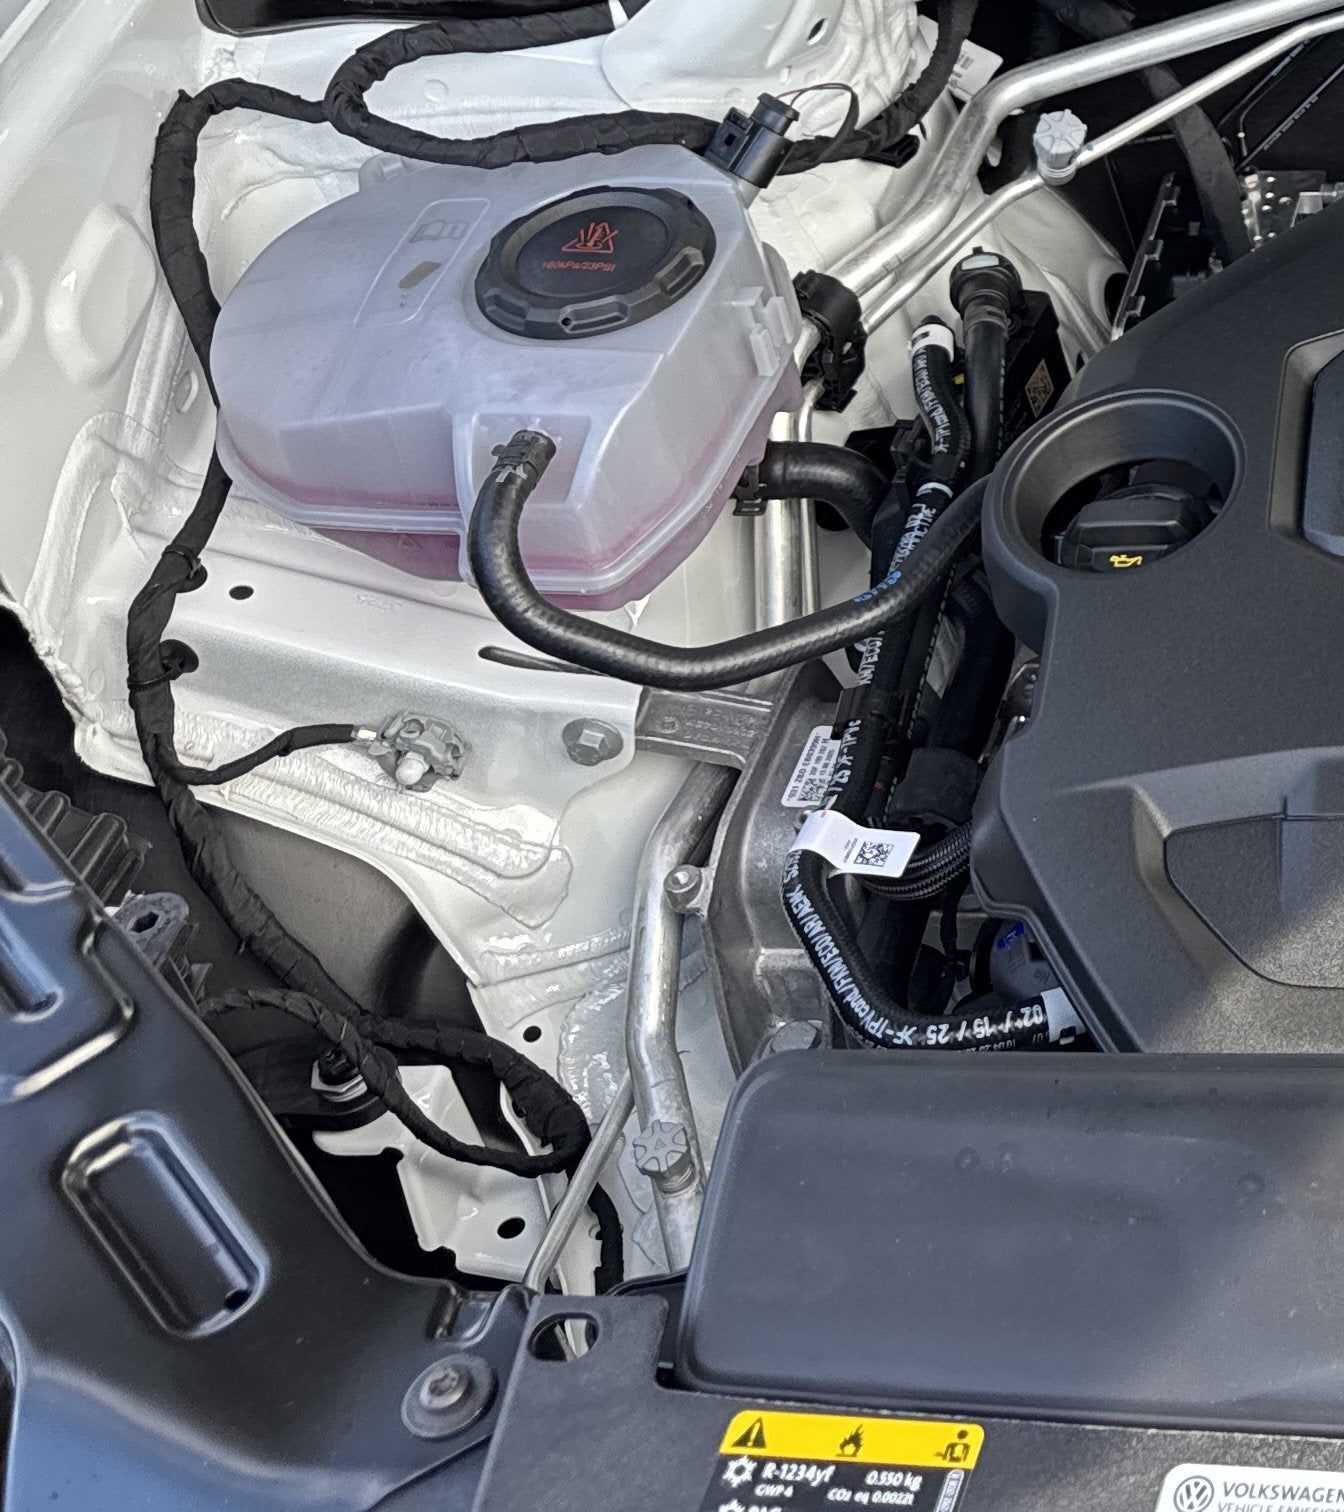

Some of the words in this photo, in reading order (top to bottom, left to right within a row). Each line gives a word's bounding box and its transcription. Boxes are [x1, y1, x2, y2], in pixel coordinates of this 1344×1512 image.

[925, 1023, 950, 1047] 25
[761, 1461, 837, 1487] R-1234yf
[903, 1473, 924, 1492] kg
[854, 1491, 870, 1505] eq
[1217, 1502, 1273, 1512] VEHICLE
